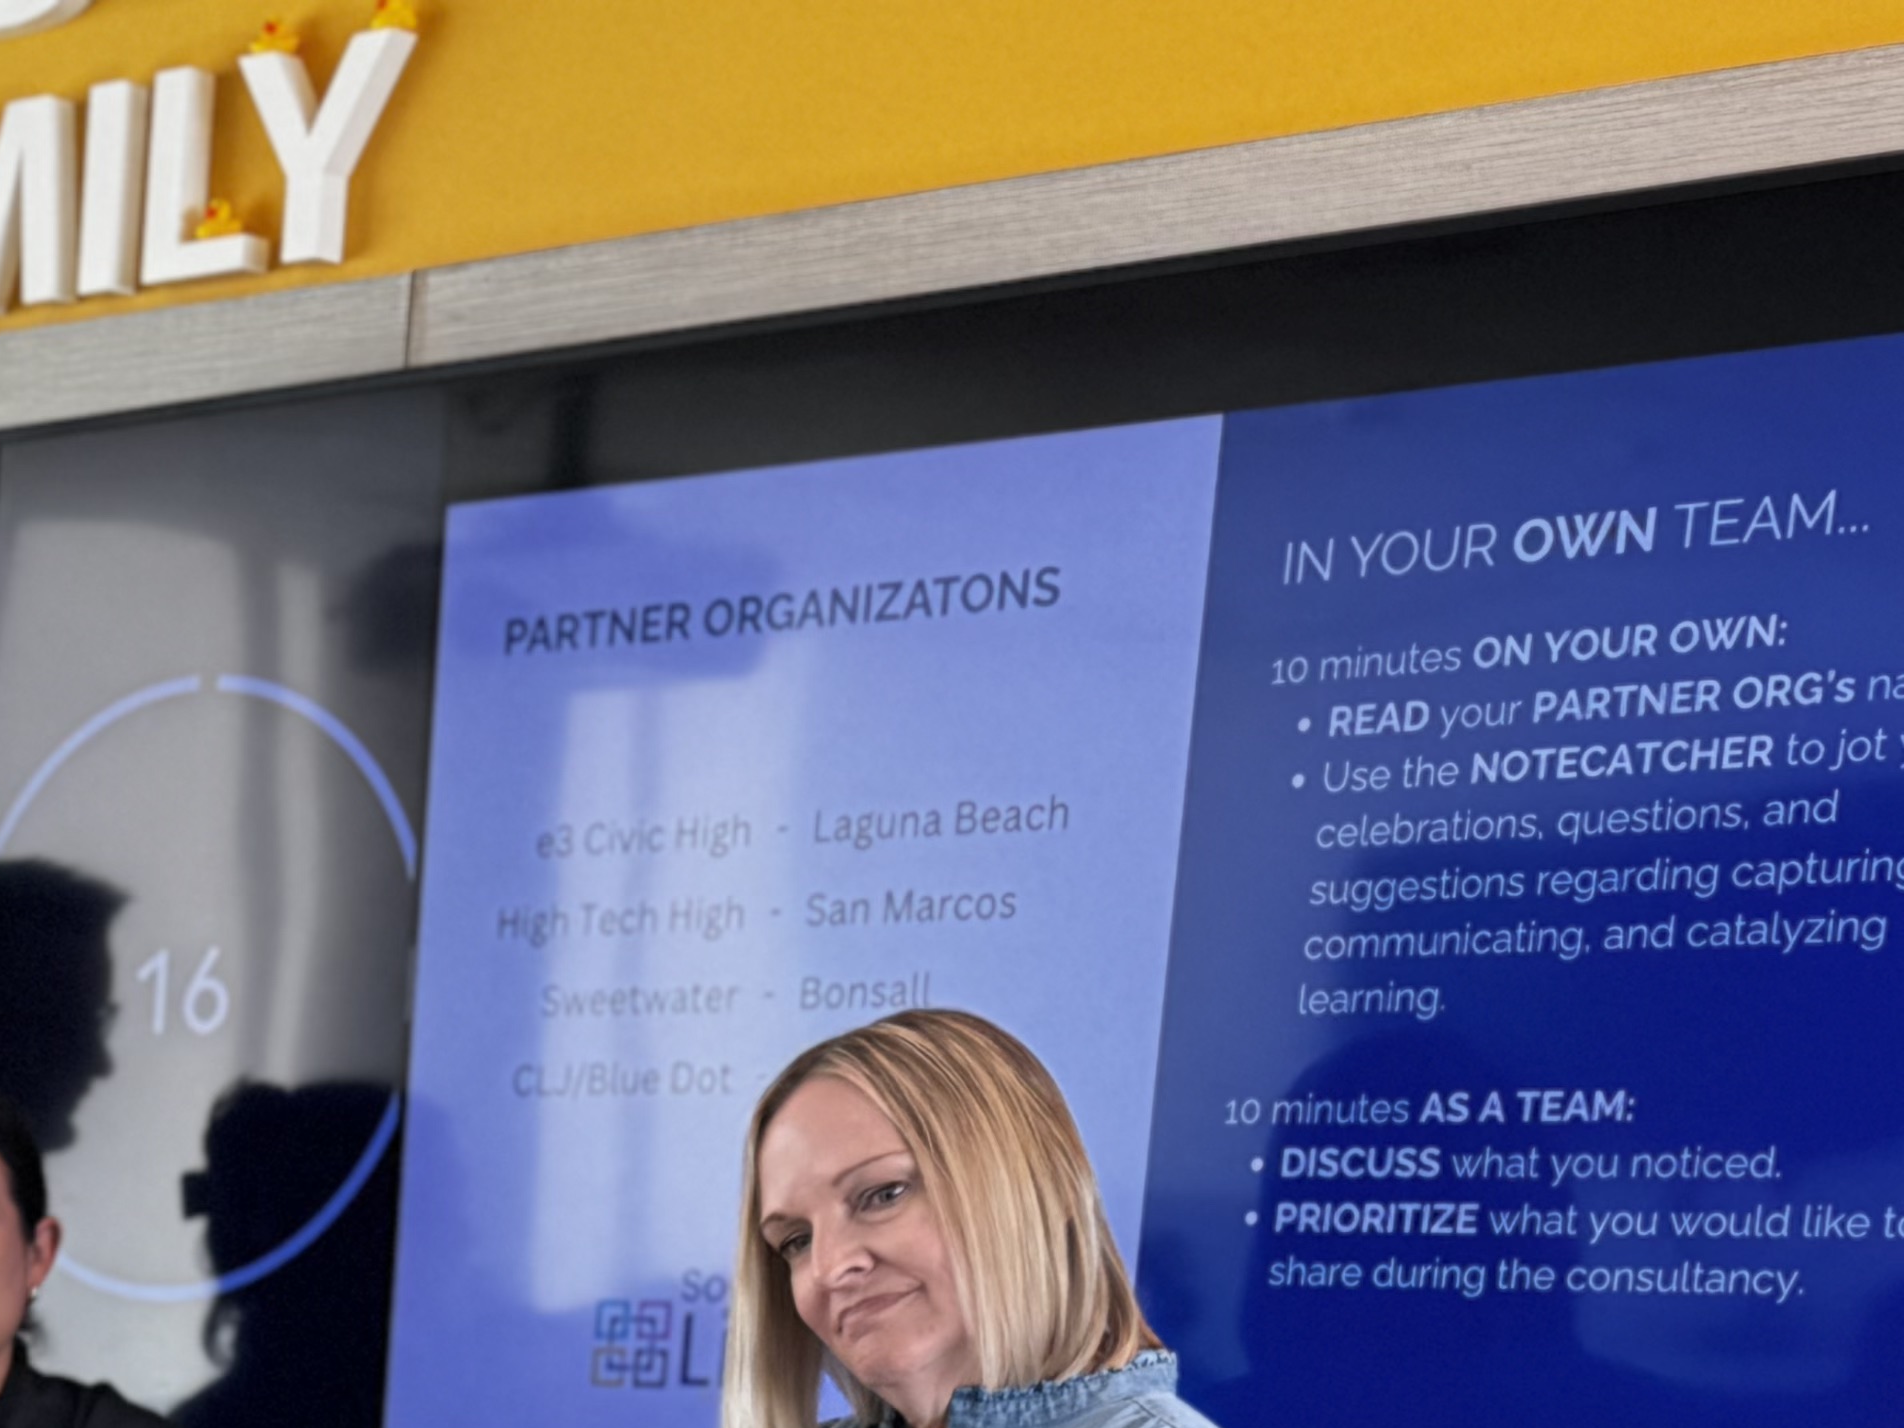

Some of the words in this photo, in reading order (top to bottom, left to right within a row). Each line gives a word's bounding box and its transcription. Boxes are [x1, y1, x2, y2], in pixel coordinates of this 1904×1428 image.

[1283, 538, 1333, 585] IN
[1352, 523, 1498, 578] YOUR
[1513, 506, 1656, 562] OWN
[1674, 489, 1870, 548] TEAM...
[503, 602, 692, 657] PARTNER
[703, 566, 1061, 639] ORGANIZATONS
[1270, 658, 1308, 684] 10
[1320, 642, 1462, 682] minutes
[1473, 633, 1532, 669] ON
[1545, 623, 1657, 662] YOUR
[1669, 613, 1787, 653] OWN:
[1328, 700, 1429, 737] READ
[1440, 701, 1521, 739] your
[1532, 679, 1720, 724] PARTNER
[1733, 670, 1856, 711] ORG's
[1323, 760, 1391, 792] Use
[1402, 755, 1459, 788] the
[1470, 735, 1774, 784] NOTECATCHER
[1786, 732, 1825, 766] to
[1829, 727, 1889, 771] jot
[536, 825, 575, 859] e3
[583, 817, 665, 857] Civic
[674, 813, 751, 859] High
[813, 808, 943, 851] Laguna
[954, 795, 1070, 835] Beach
[1316, 809, 1544, 849] celebrations,
[1557, 797, 1750, 844] questions,
[1762, 790, 1839, 828] and
[1309, 867, 1526, 912] suggestions
[1535, 856, 1719, 902] regarding
[496, 905, 568, 947] High
[581, 902, 658, 936] Tech
[669, 900, 745, 942] High
[806, 893, 871, 927] San
[882, 890, 1017, 924] Marcos
[1303, 921, 1592, 960] communicating,
[1603, 915, 1676, 951] and
[1686, 909, 1889, 953] catalyzing
[137, 947, 230, 1035] 16
[542, 982, 740, 1019] Sweetwater
[799, 971, 933, 1011] Bonsall
[1298, 981, 1446, 1020] learning.
[671, 1062, 732, 1096] Dot
[1224, 1099, 1261, 1126] 10
[1271, 1094, 1410, 1124] minutes
[1419, 1091, 1470, 1123] AS
[1477, 1091, 1506, 1122] A
[1517, 1089, 1636, 1122] TEAM:
[1281, 1146, 1441, 1179] DISCUSS
[1452, 1146, 1540, 1179] what
[1550, 1150, 1619, 1187] you
[1631, 1146, 1782, 1179] noticed.
[1274, 1202, 1479, 1235] PRIORITIZE
[1489, 1204, 1578, 1236] what
[1589, 1208, 1658, 1243] you
[1671, 1204, 1791, 1238] would
[1802, 1204, 1871, 1238] like
[1268, 1255, 1363, 1287] share
[1372, 1258, 1486, 1298] during
[1498, 1257, 1557, 1291] the
[1566, 1260, 1804, 1304] consultancy.
